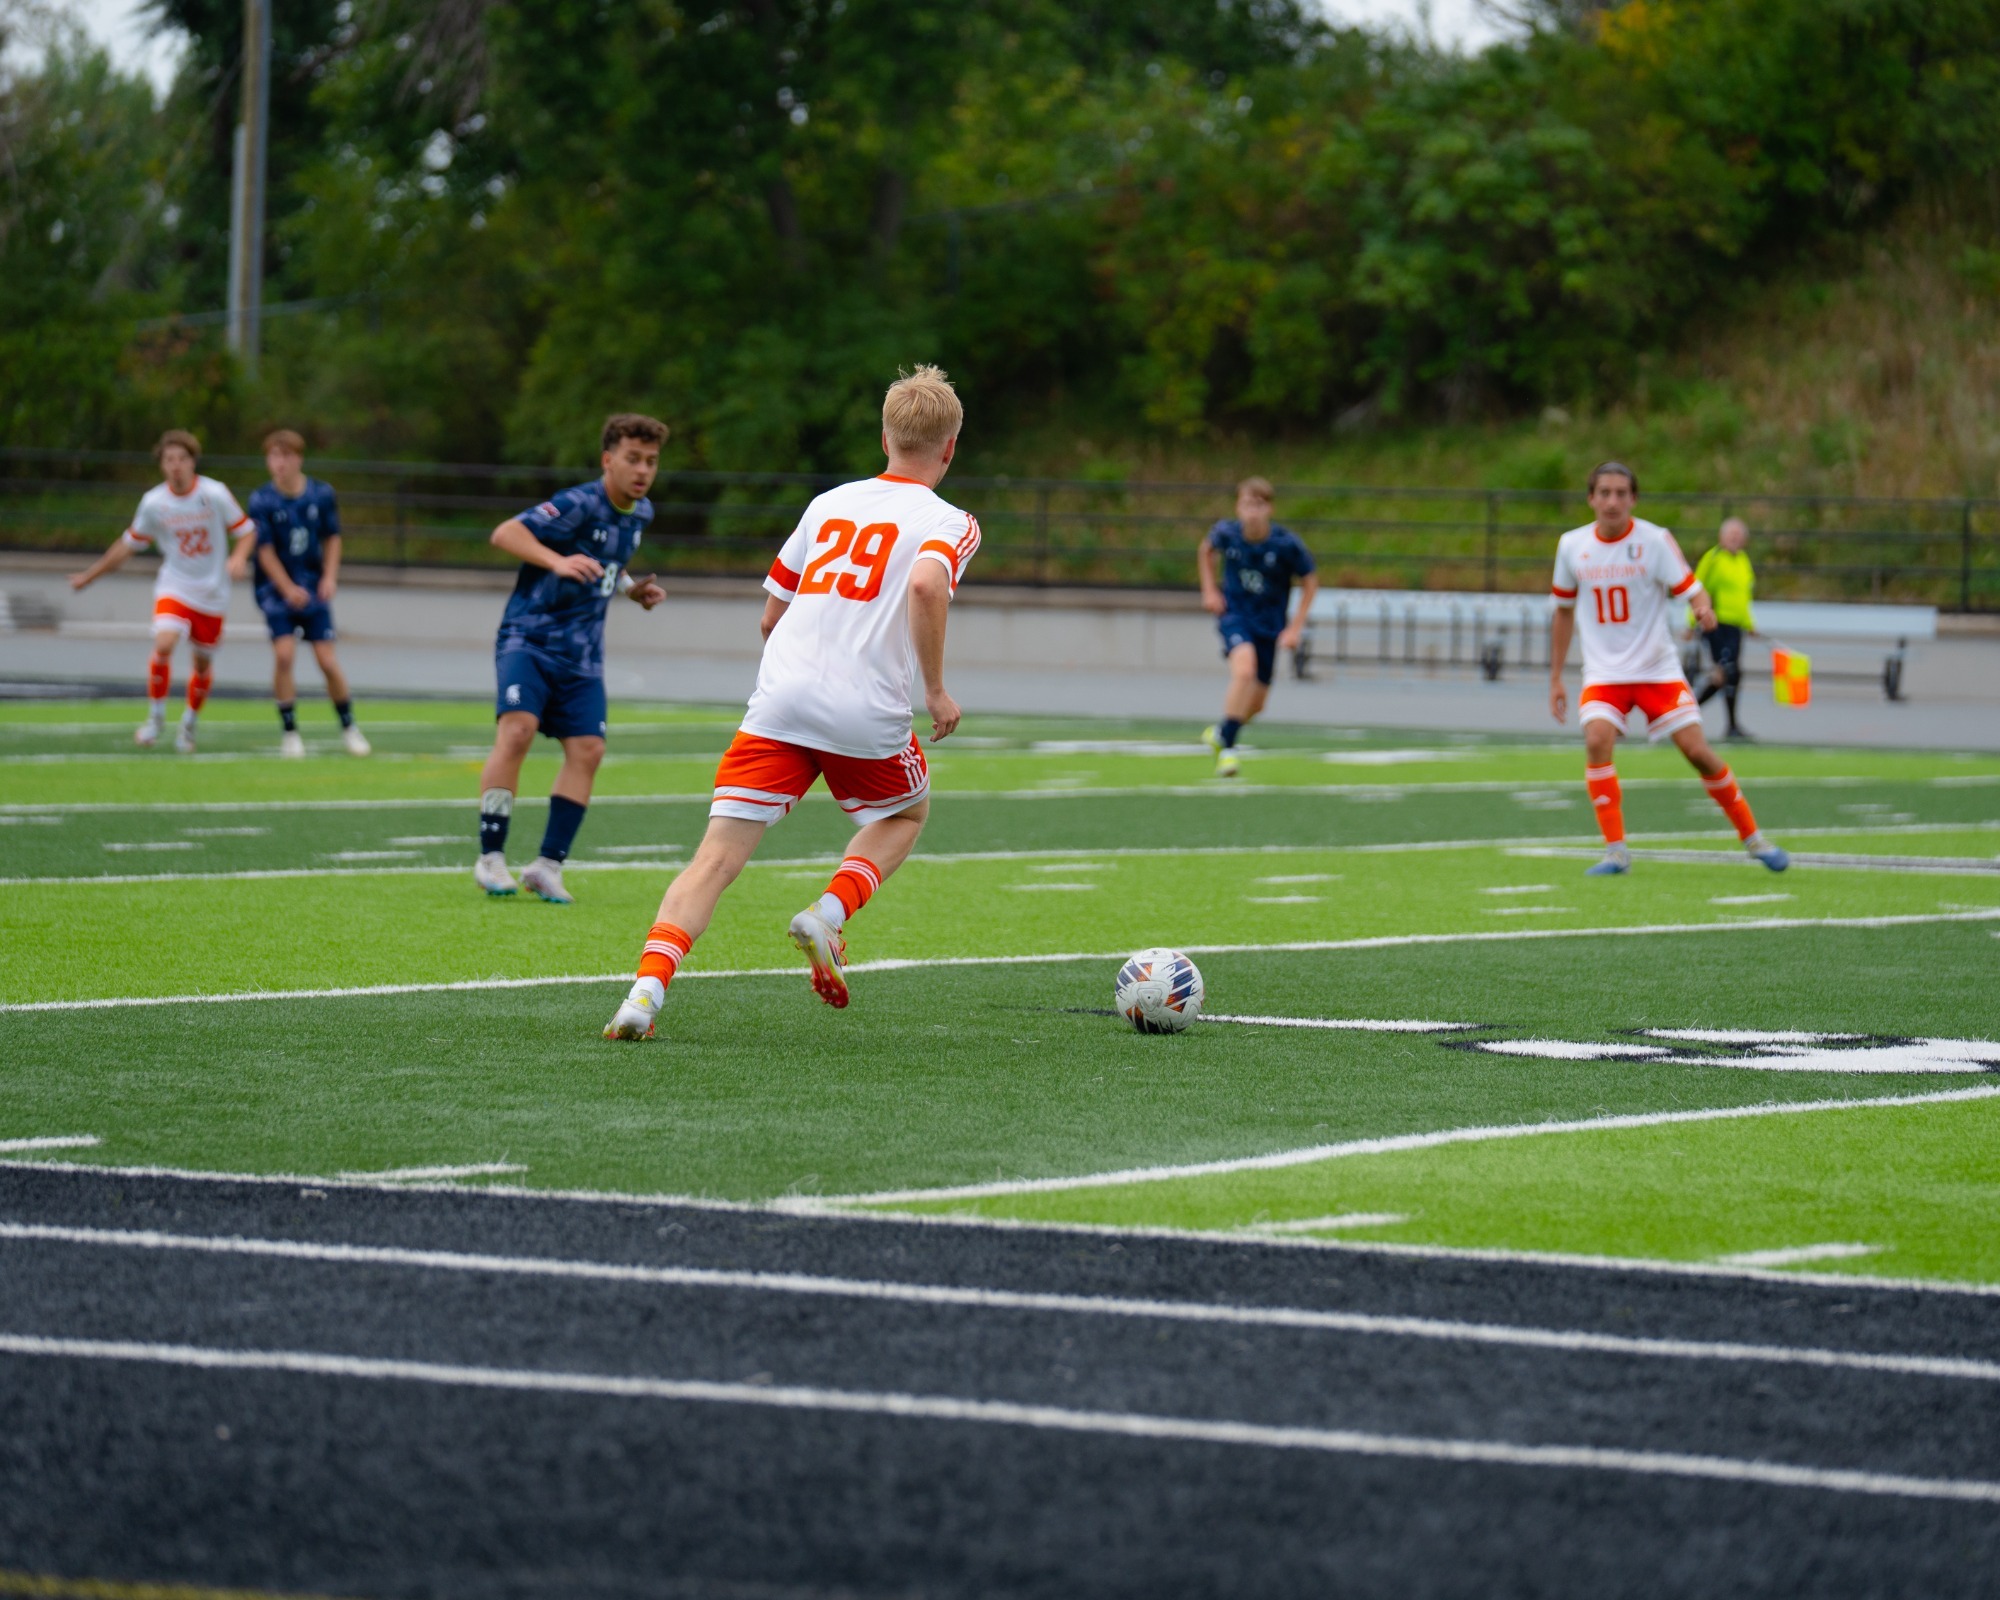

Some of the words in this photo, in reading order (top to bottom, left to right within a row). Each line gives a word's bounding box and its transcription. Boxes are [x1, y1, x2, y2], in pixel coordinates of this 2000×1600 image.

[176, 528, 213, 558] 22
[797, 518, 900, 603] 29
[1593, 586, 1629, 623] 10
